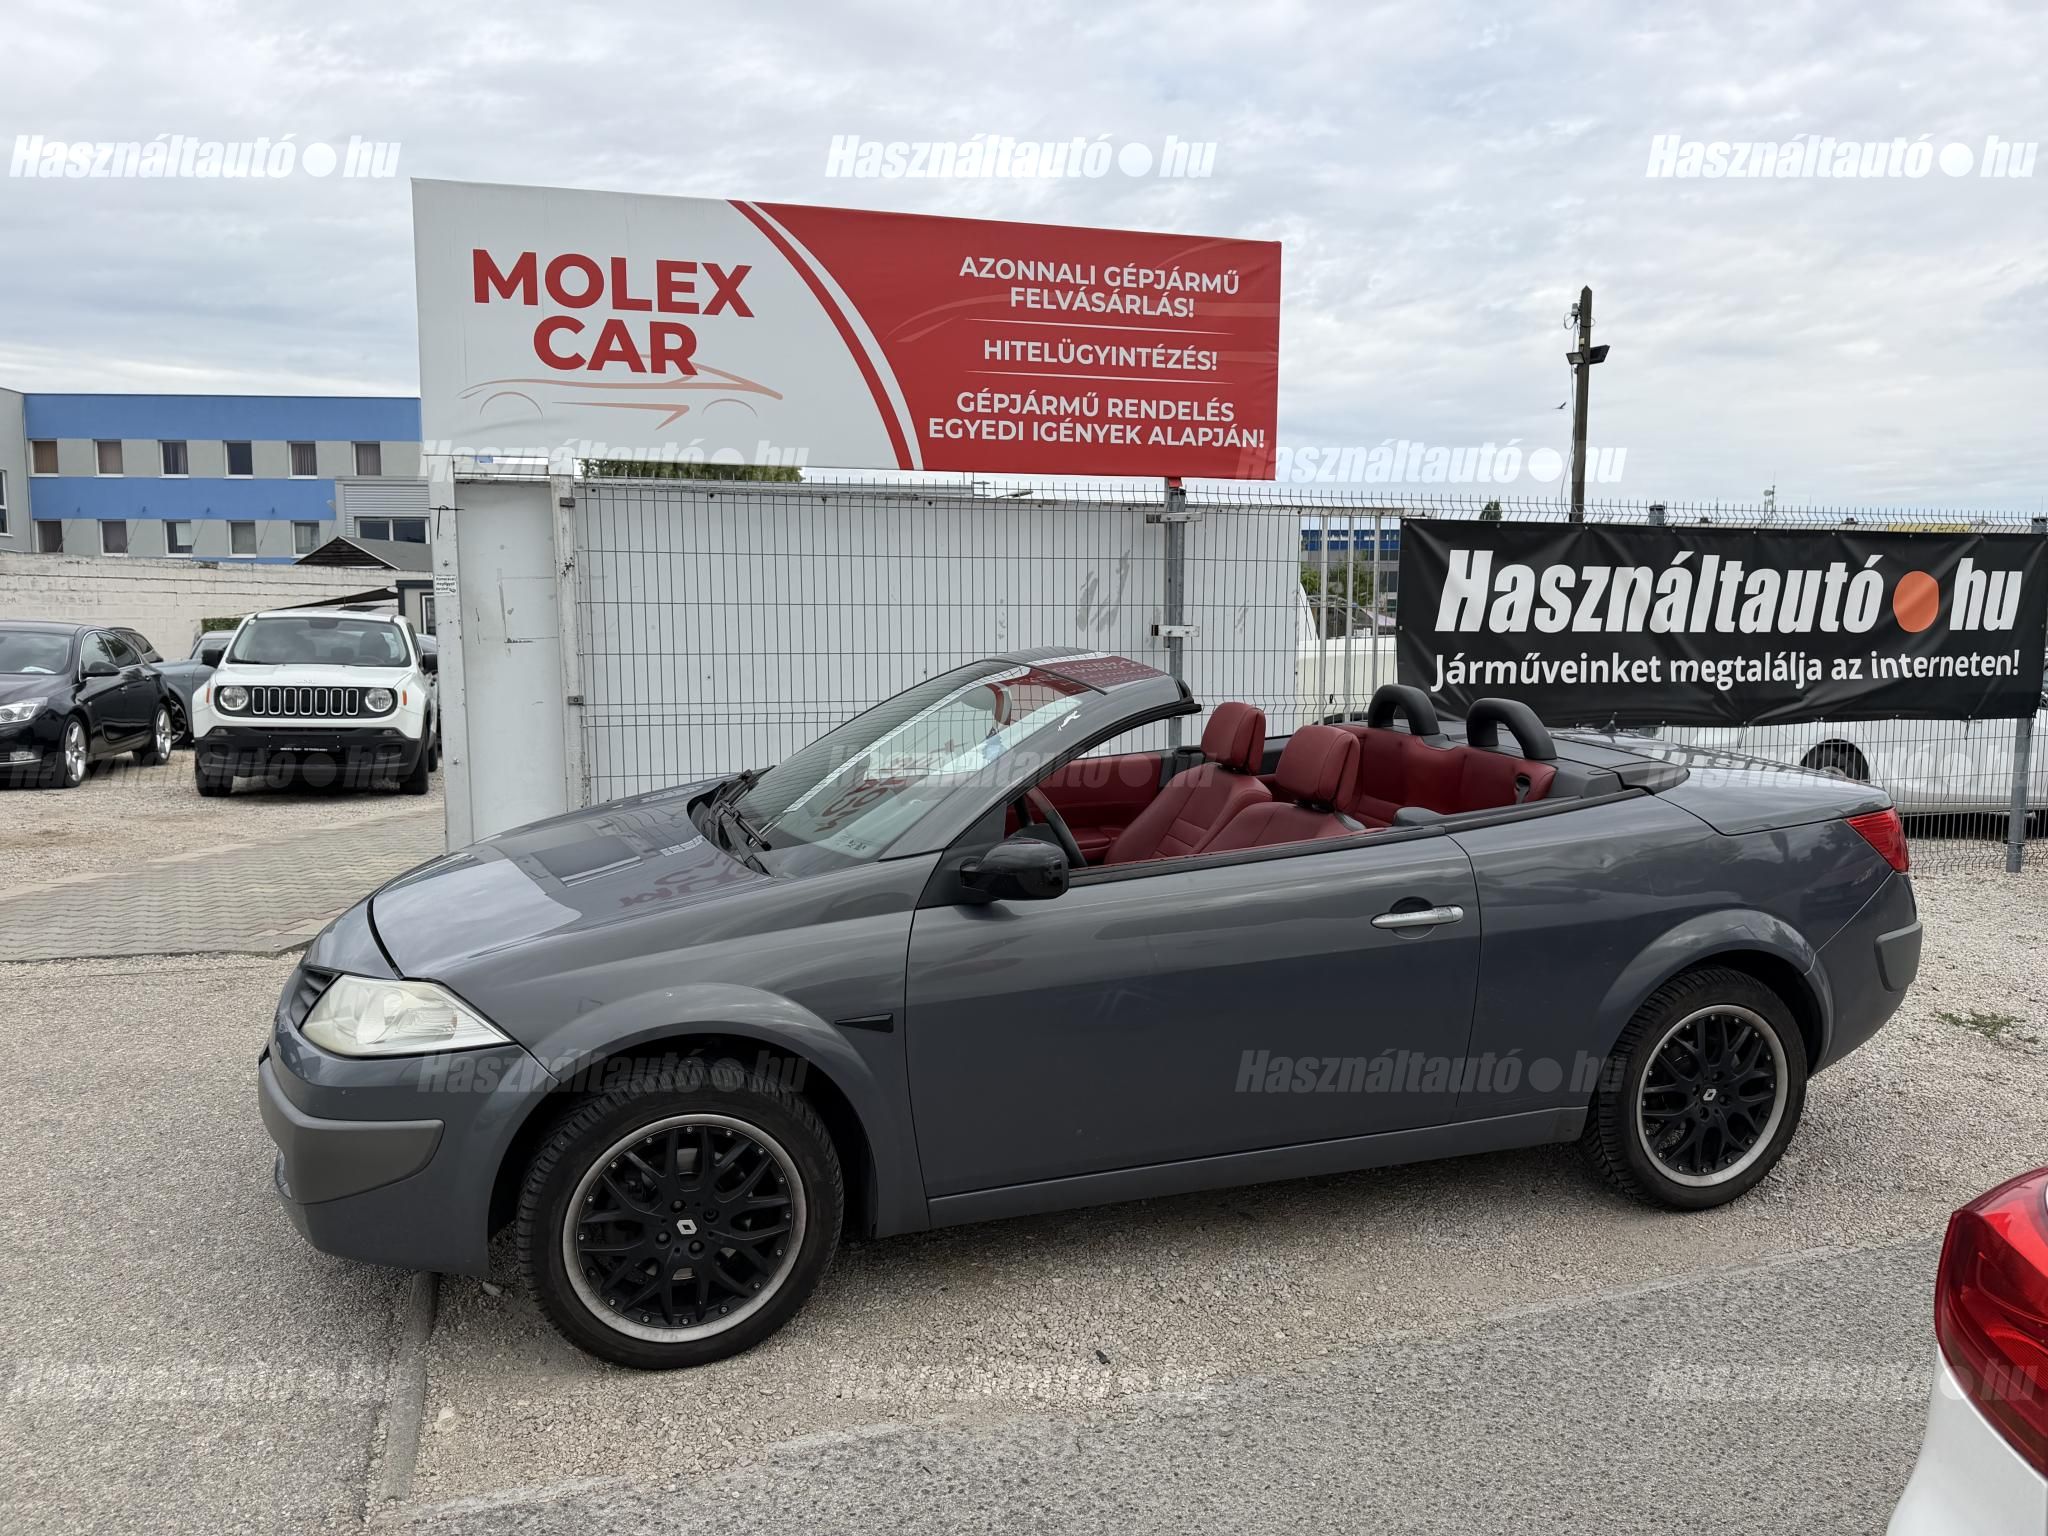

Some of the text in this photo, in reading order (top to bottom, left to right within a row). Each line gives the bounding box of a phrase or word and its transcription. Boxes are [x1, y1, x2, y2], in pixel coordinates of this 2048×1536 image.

[474, 249, 755, 318] MOLEX
[960, 256, 1239, 295] AZONNALI GÉPJÁRMŰ
[1010, 286, 1195, 318] FELVÁSÁRLÁS!
[533, 315, 698, 376] CAR
[983, 338, 1218, 371] HITELÜGYINTÉZÉS!
[956, 387, 1235, 422] GÉPJÁRMŰ RENDELÉS
[929, 418, 1265, 449] EGYEDI IGÉNYEK ALAPJÁN!
[1435, 550, 2023, 634] Használtautó hu
[1431, 649, 2020, 693] Járműveinket megtalálja az interneten!
